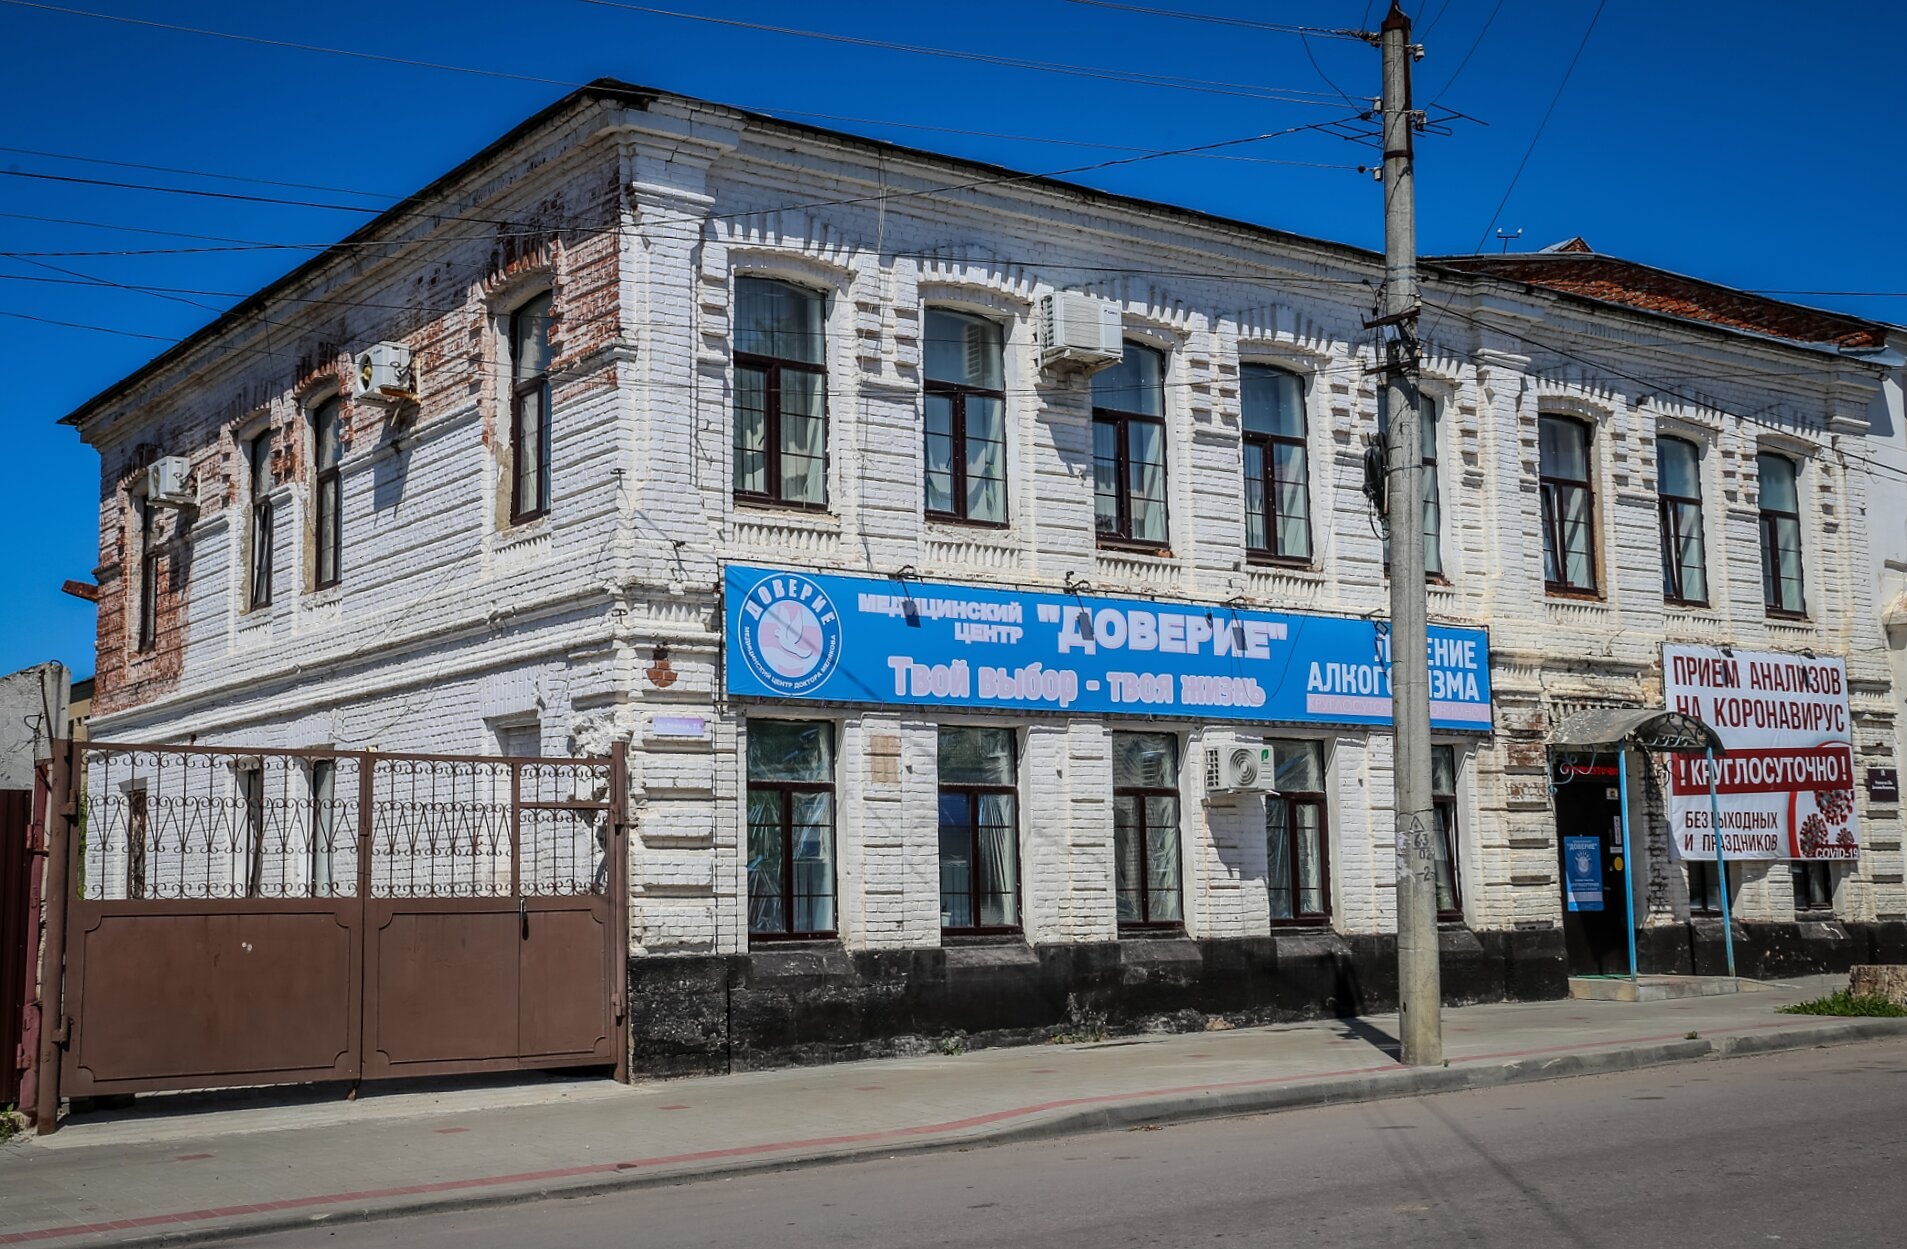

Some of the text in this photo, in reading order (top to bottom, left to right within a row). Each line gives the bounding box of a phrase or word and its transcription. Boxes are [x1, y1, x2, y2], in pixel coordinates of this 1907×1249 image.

[745, 578, 836, 626] ДОВЕРИЕ
[858, 592, 1023, 624] МЕДИЦИНСКИЙ
[954, 621, 1023, 645] ЦЕНТР
[1037, 603, 1288, 660] "ДОВЕРИЕ"
[794, 672, 823, 690] ДОКТОРА
[1085, 678, 1100, 691] -
[1673, 655, 1841, 695] ПРИЕМ АНАЛИЗОВ
[1676, 695, 1845, 733] НА КОРОНАВИРУС
[1685, 811, 1708, 829] БЕЗ
[1685, 834, 1694, 852] И
